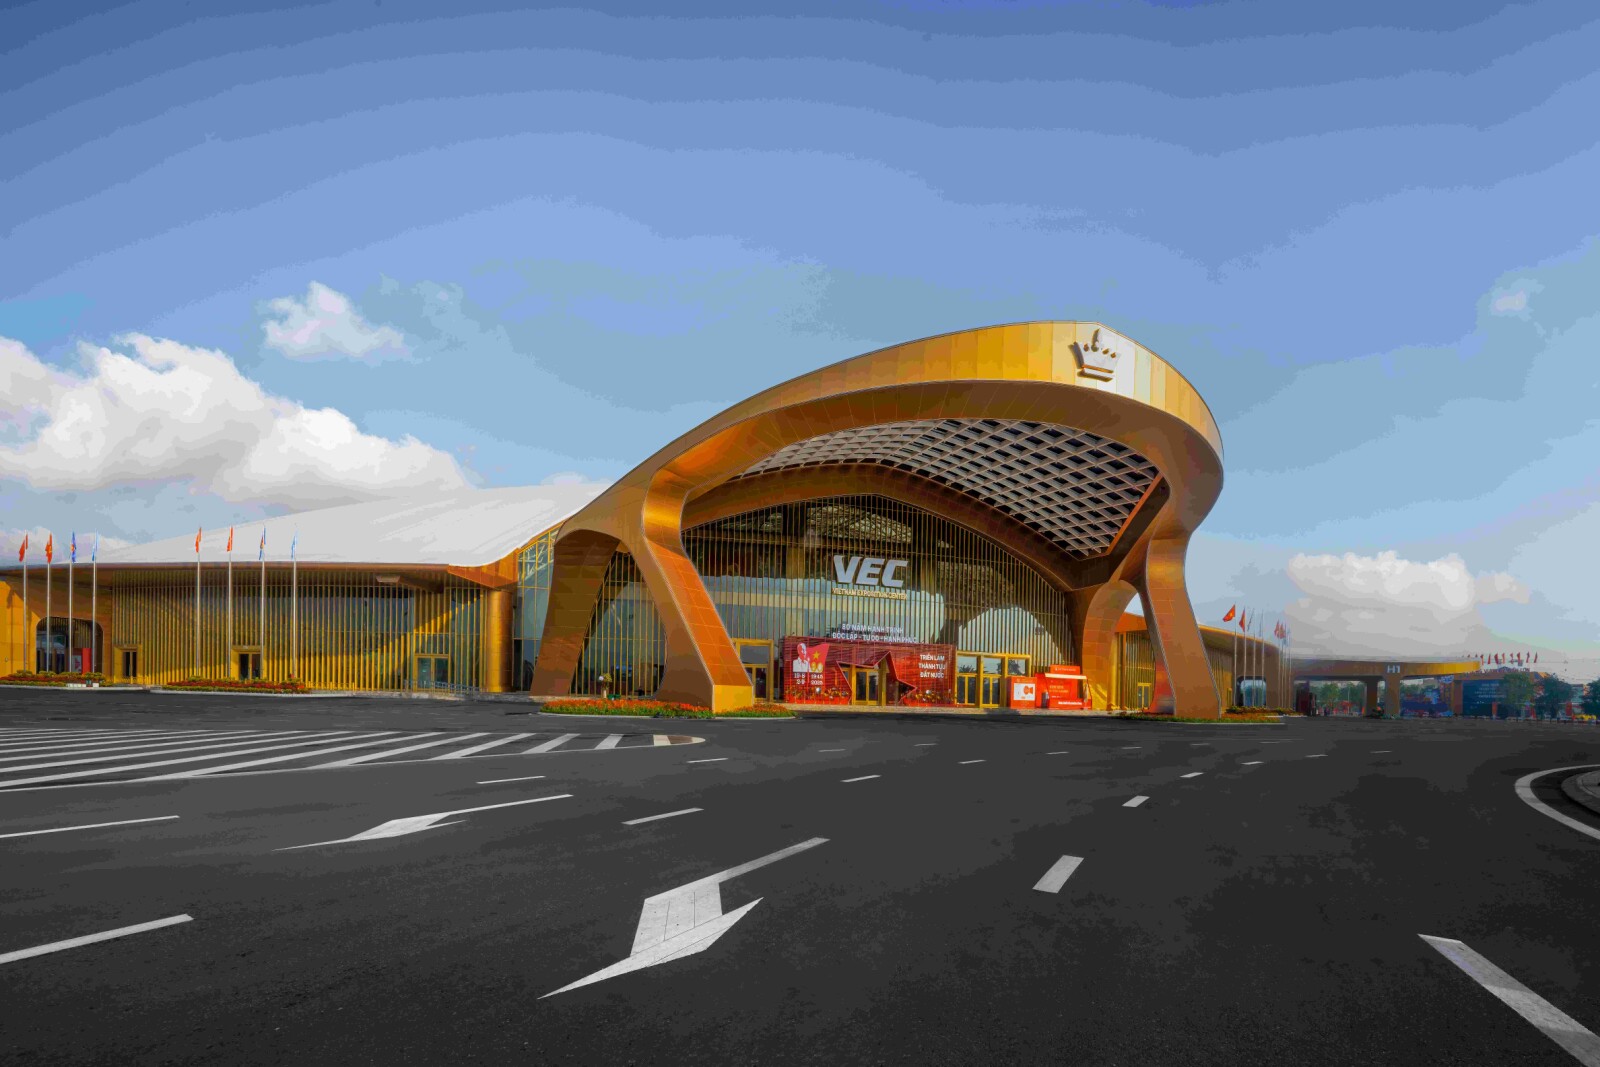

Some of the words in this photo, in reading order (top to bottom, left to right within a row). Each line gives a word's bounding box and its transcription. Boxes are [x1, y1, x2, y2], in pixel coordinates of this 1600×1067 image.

[834, 555, 908, 587] VEC
[832, 587, 857, 596] VIETNAM
[888, 592, 908, 600] CENTER
